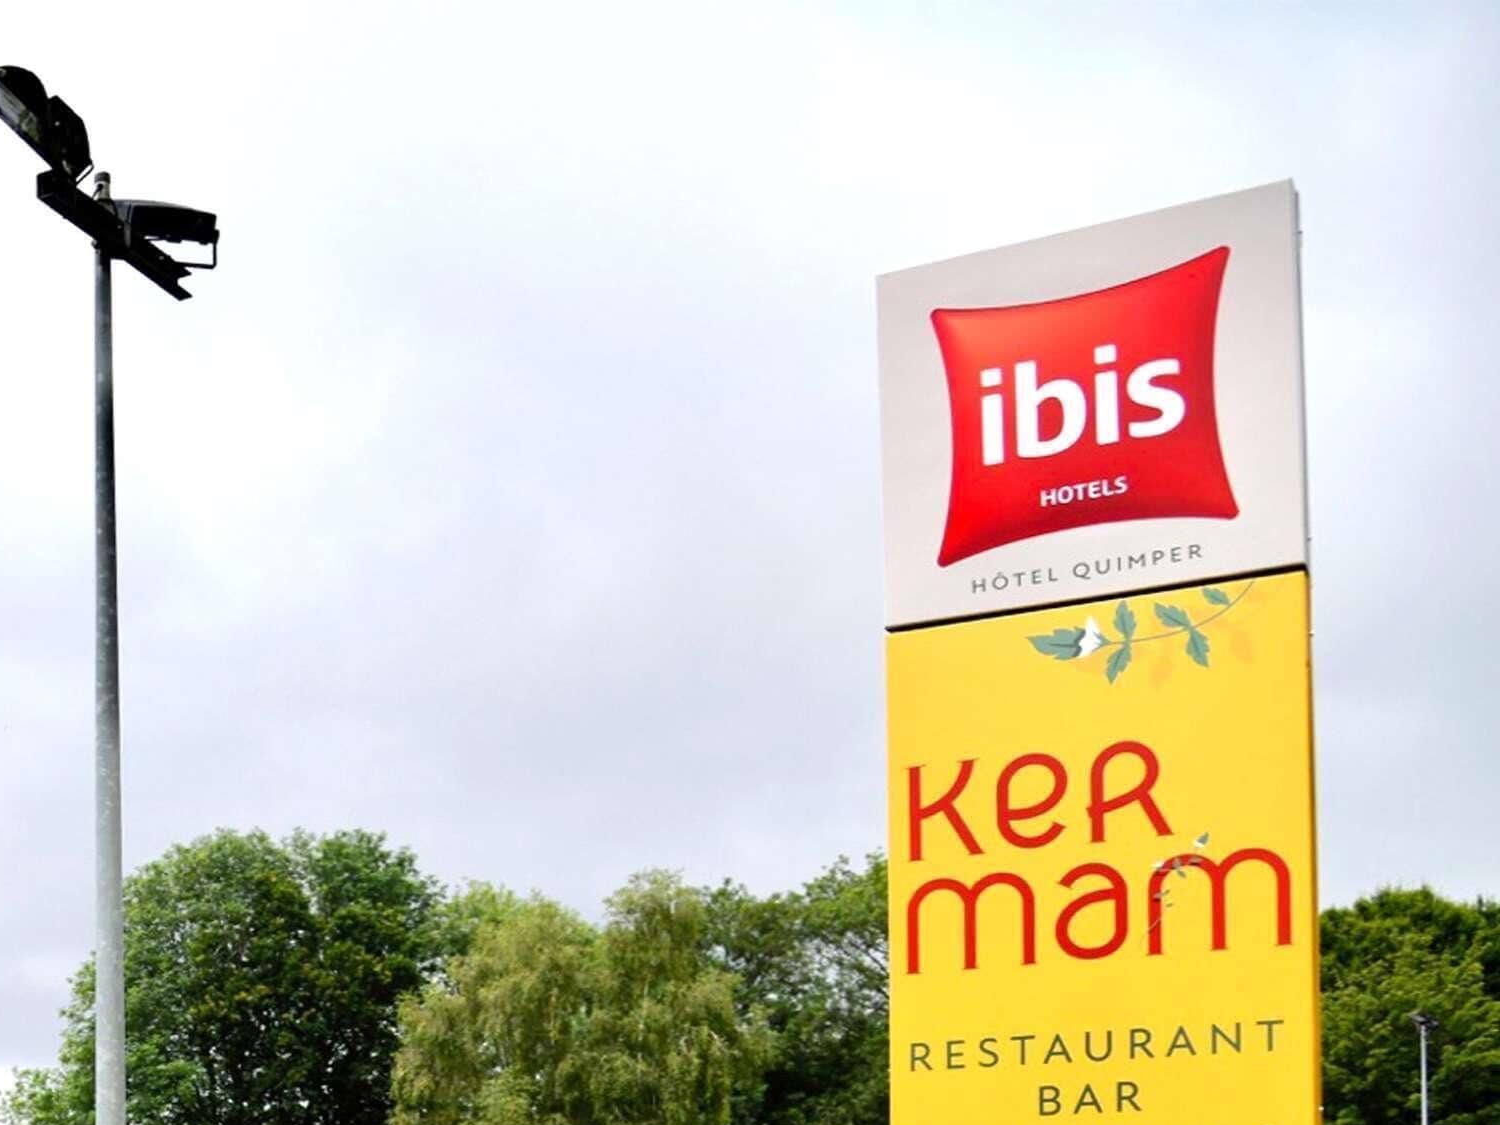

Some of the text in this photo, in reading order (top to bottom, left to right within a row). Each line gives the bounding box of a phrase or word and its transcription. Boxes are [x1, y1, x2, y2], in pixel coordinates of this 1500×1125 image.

[979, 344, 1186, 467] ibis
[1039, 475, 1129, 508] HOTELS
[971, 543, 1204, 595] HÔTEL QUIMPER
[909, 1018, 1286, 1073] RESTAURANT
[1037, 1080, 1144, 1117] BAR
